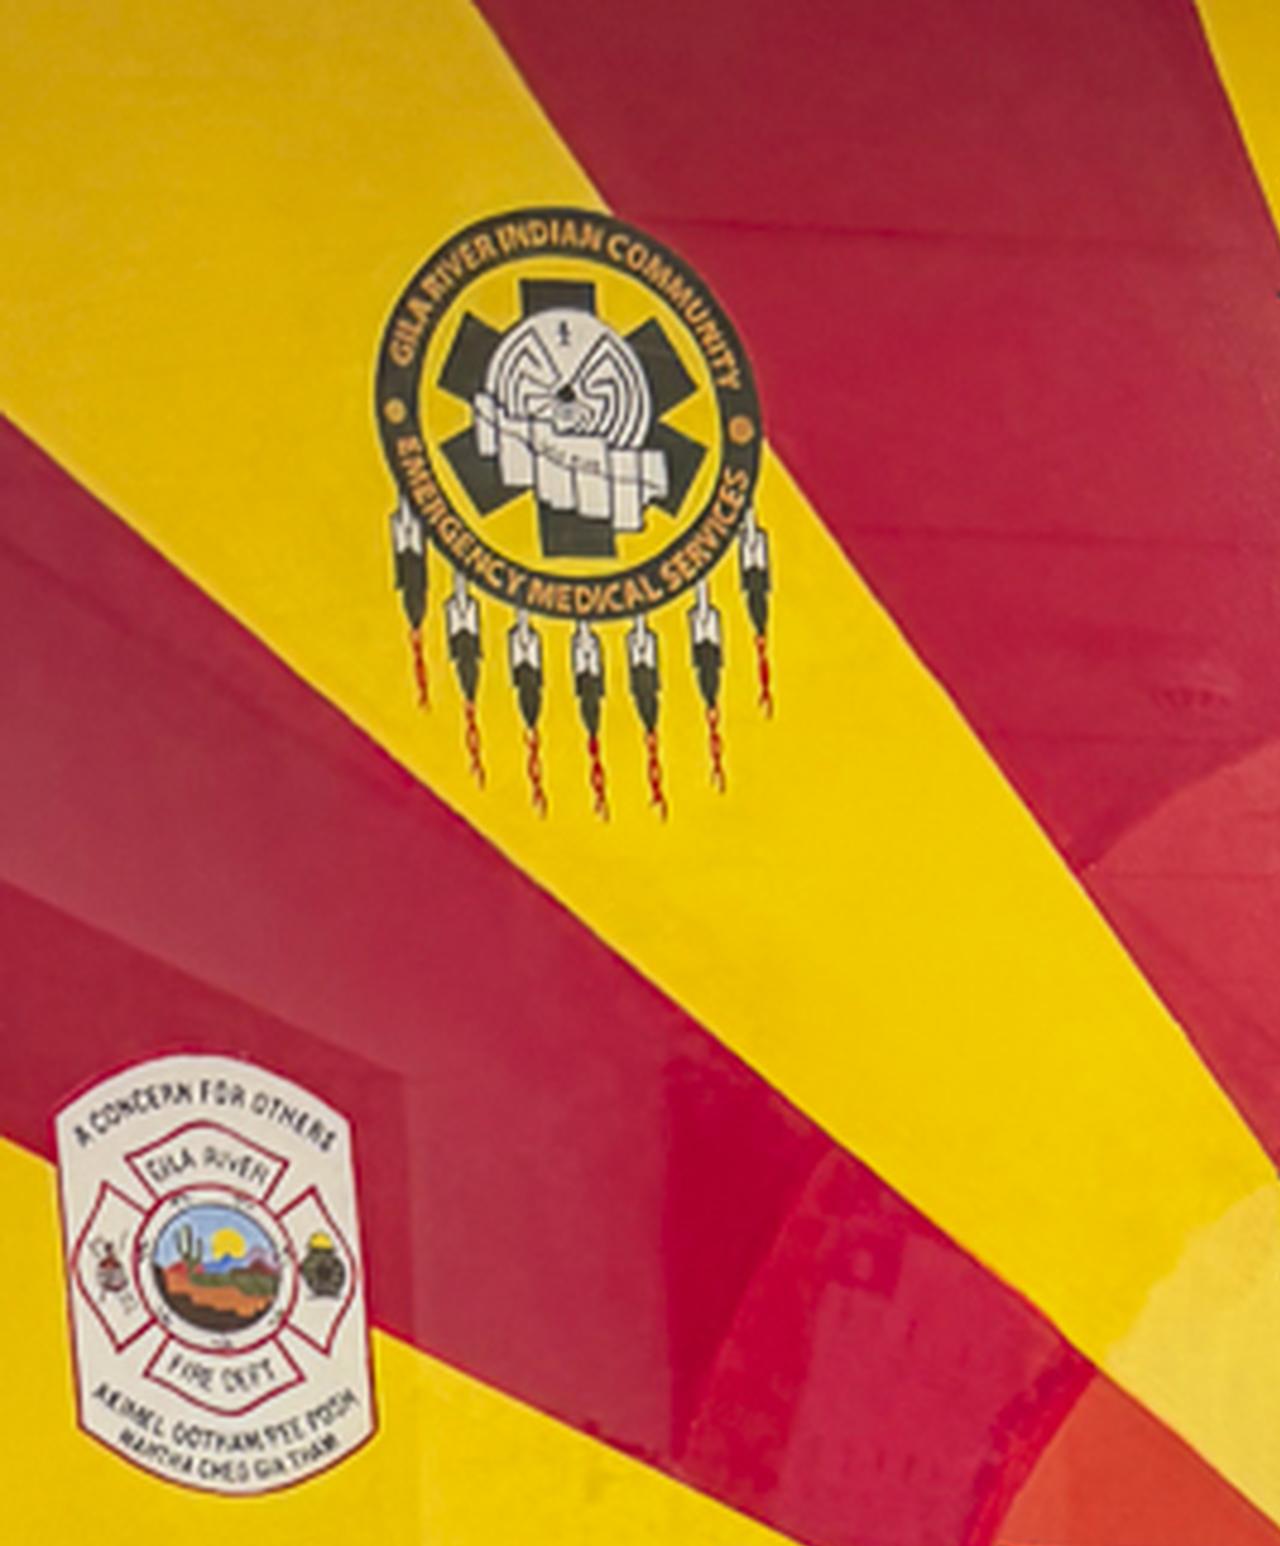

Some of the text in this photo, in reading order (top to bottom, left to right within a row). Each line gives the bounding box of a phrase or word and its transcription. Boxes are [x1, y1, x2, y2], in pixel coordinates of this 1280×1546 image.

[390, 220, 741, 392] GILA RIVER INDIAN COMMUNITY
[396, 435, 750, 613] EMERGENCY MEDICAL SERVICES
[89, 1079, 193, 1135] CONCERN
[199, 1078, 247, 1106] FOR
[249, 1092, 338, 1155] OTHERS
